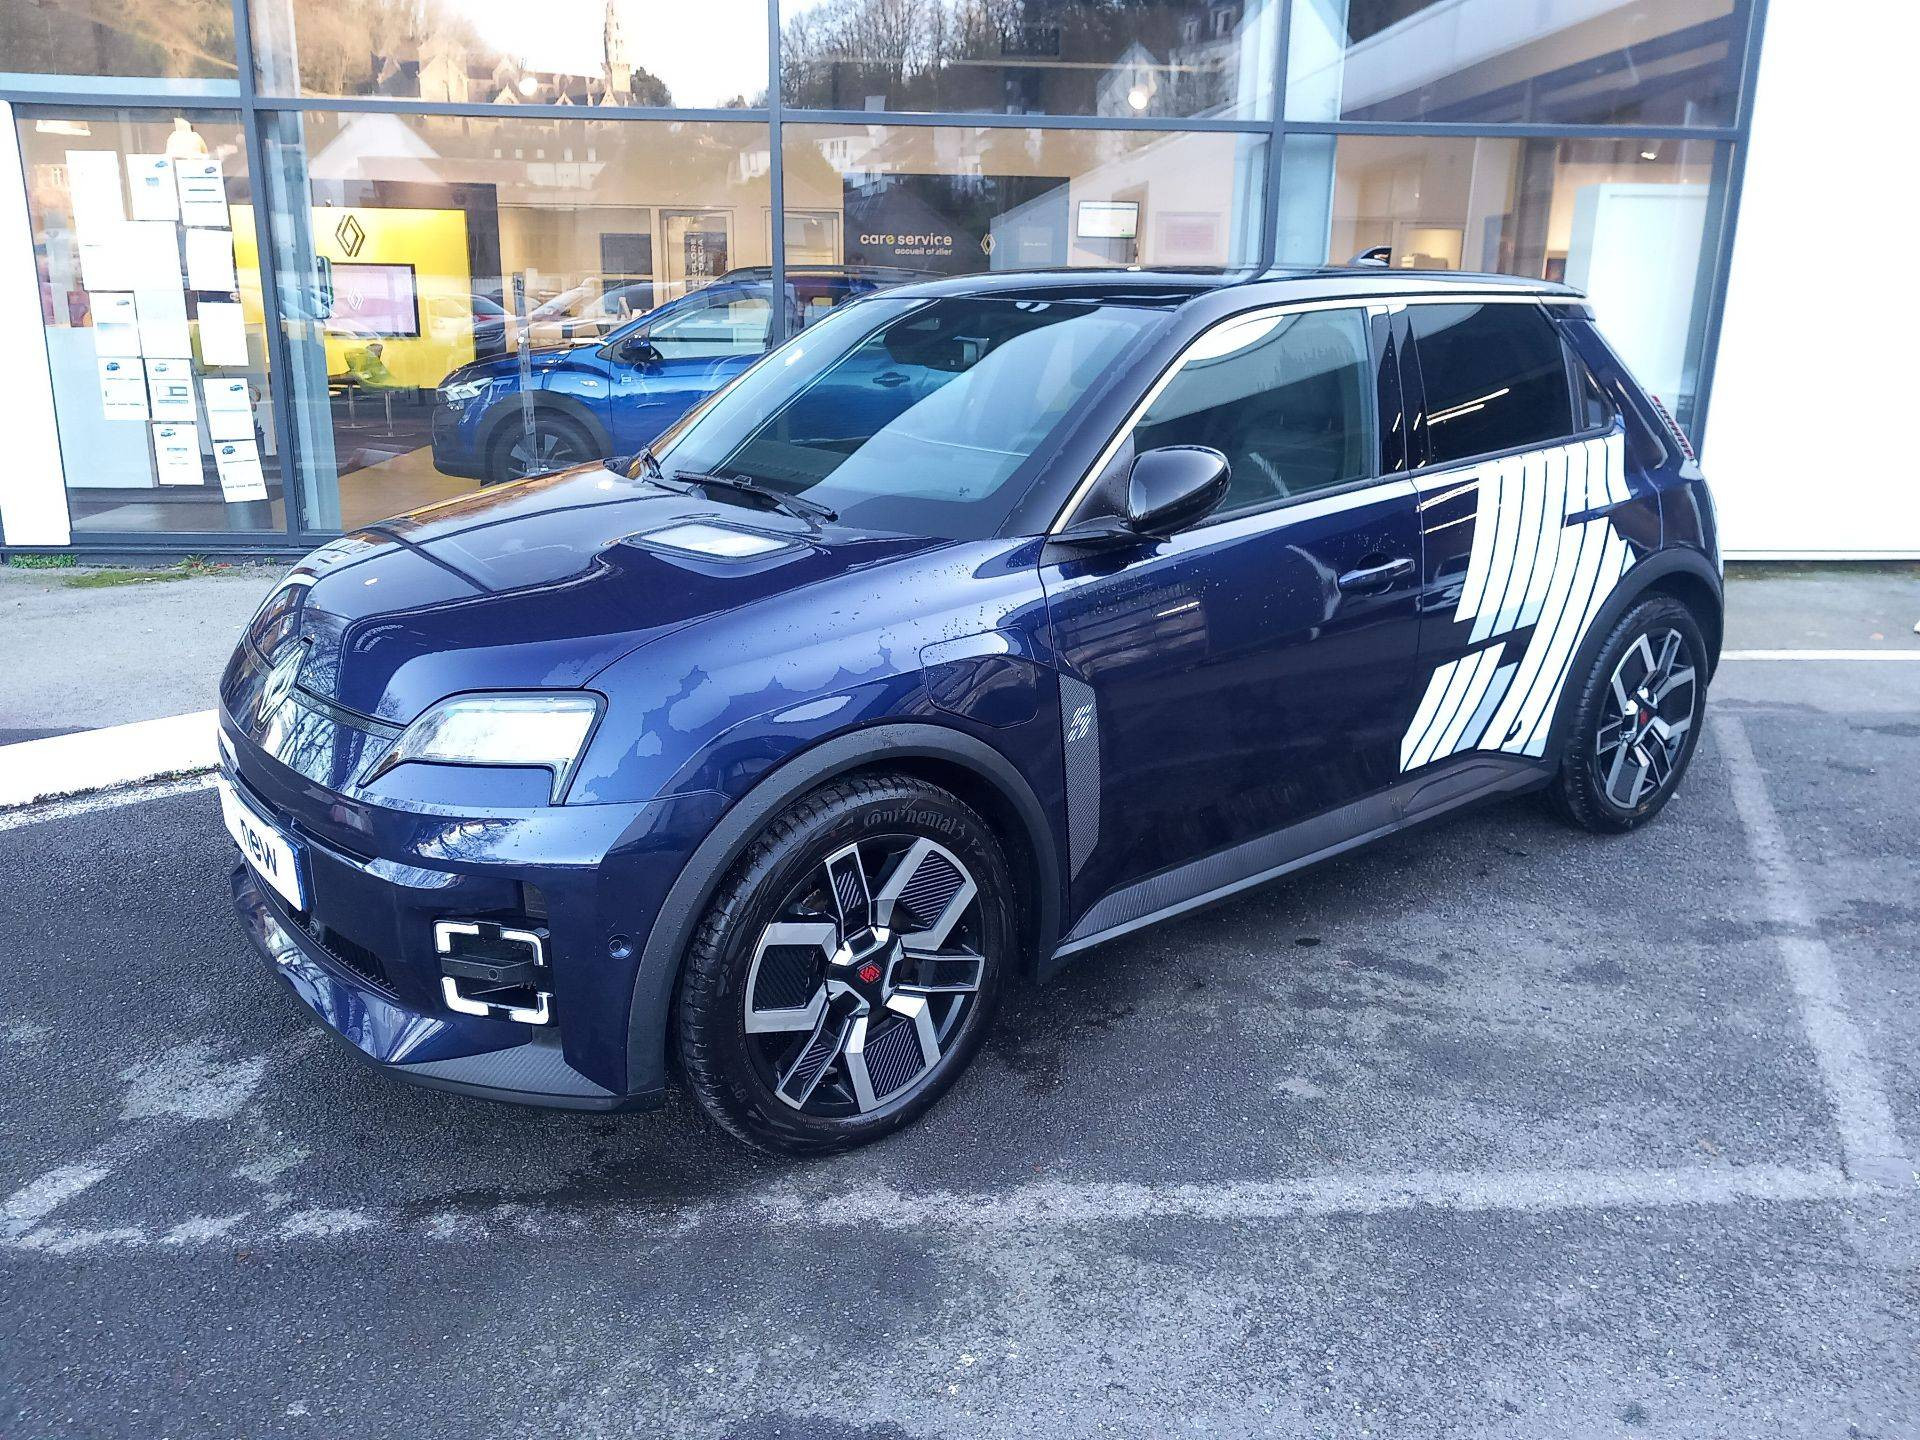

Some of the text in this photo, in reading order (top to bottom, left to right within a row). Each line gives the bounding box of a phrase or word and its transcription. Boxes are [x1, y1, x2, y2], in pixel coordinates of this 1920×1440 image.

[860, 232, 953, 246] care service
[894, 247, 925, 256] accueil
[240, 818, 278, 878] new
